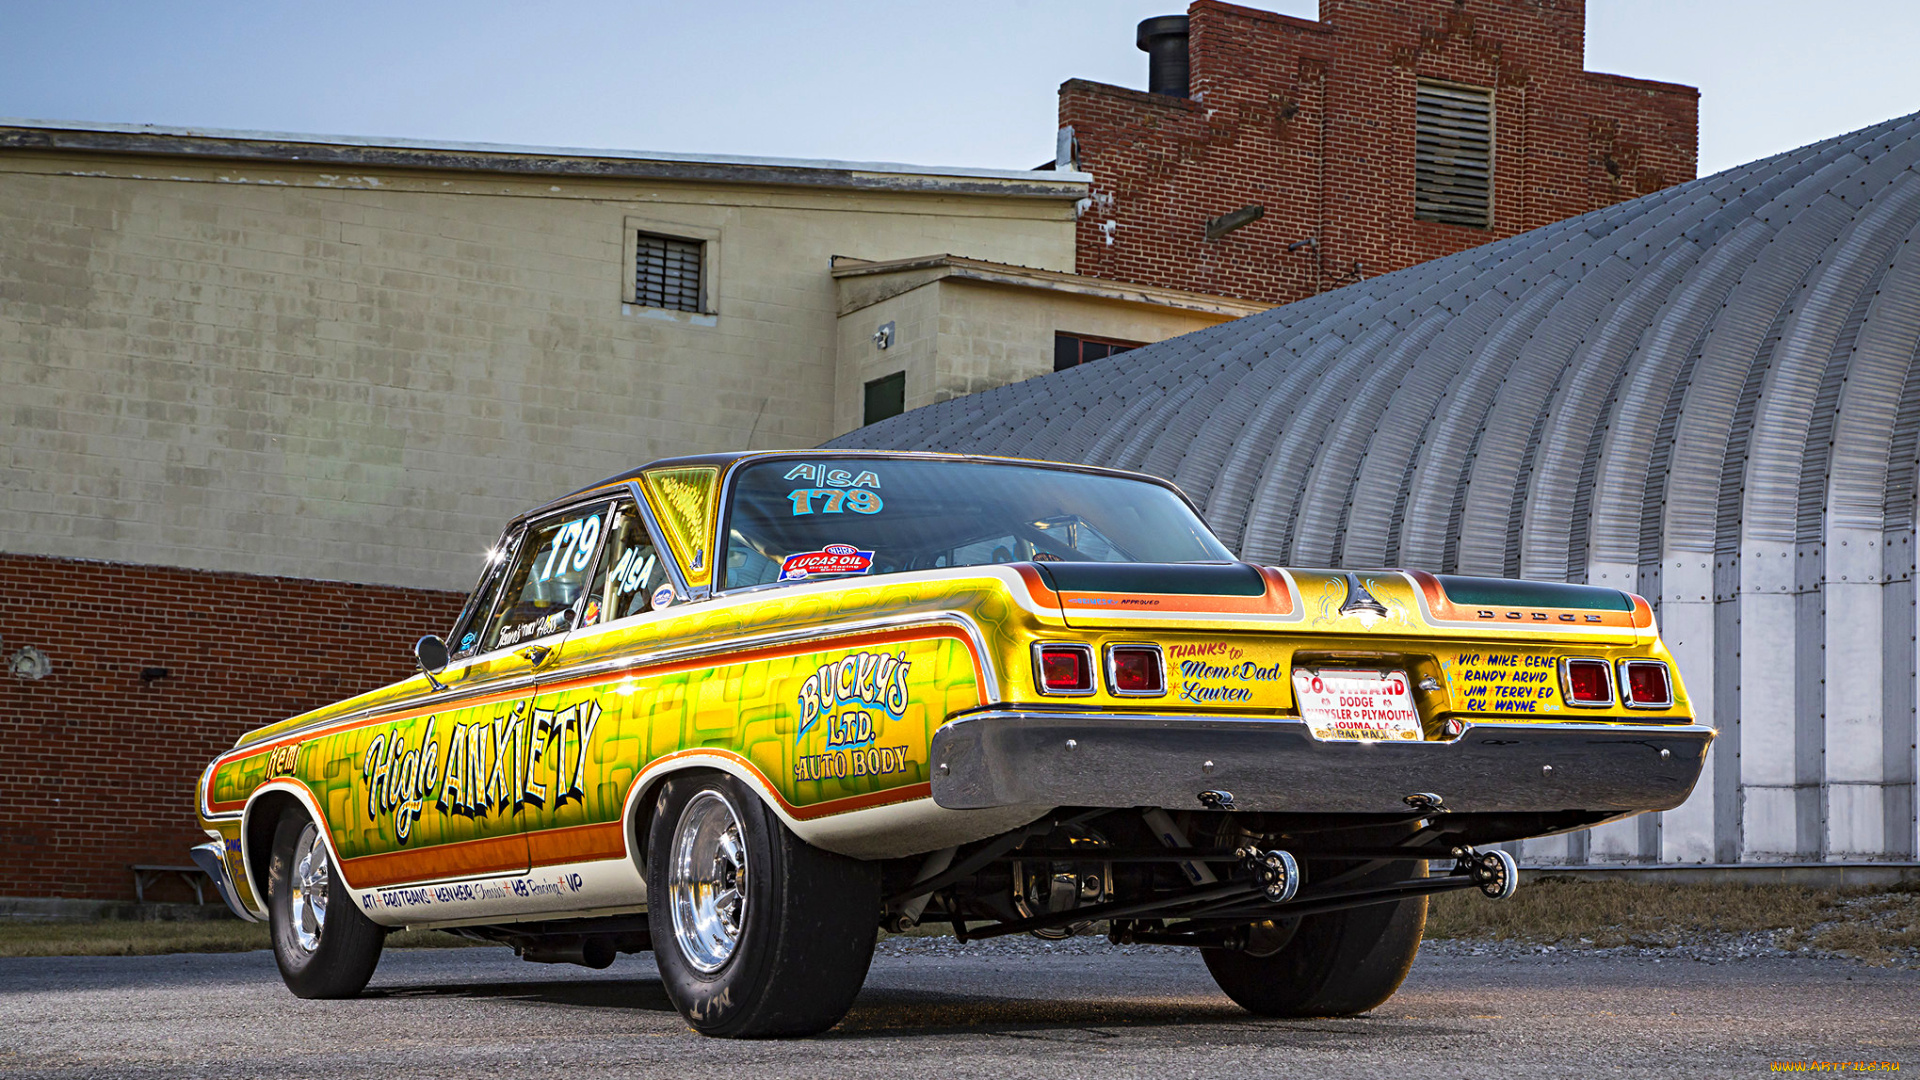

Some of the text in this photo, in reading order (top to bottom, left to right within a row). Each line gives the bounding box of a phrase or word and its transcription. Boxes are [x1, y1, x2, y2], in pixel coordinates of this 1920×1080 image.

[783, 463, 881, 488] A/SA
[787, 488, 884, 516] 179
[539, 514, 600, 582] 179
[611, 547, 656, 596] A/SA
[789, 556, 862, 569] LUCAS OIL
[1477, 610, 1602, 623] DODGE
[1169, 642, 1228, 658] THANKS
[1181, 660, 1282, 681] Mom & Dad
[1458, 654, 1480, 666] VIC
[1487, 654, 1519, 667] MIKE
[1524, 655, 1556, 668] GENE
[1464, 670, 1548, 683] RANDY ARVID
[1179, 680, 1253, 704] Lauren
[1339, 697, 1374, 707] DODGE
[1464, 685, 1554, 699] JIM TERRY ED
[1362, 710, 1413, 721] PLYMOUTH
[1467, 699, 1487, 711] RK
[1495, 700, 1538, 712] WAYNE
[825, 710, 877, 752] LTD.
[794, 745, 909, 782] AUTO BODY
[363, 714, 440, 846] High
[511, 879, 529, 897] KB
[527, 878, 564, 900] Racing
[565, 873, 583, 892] VP
